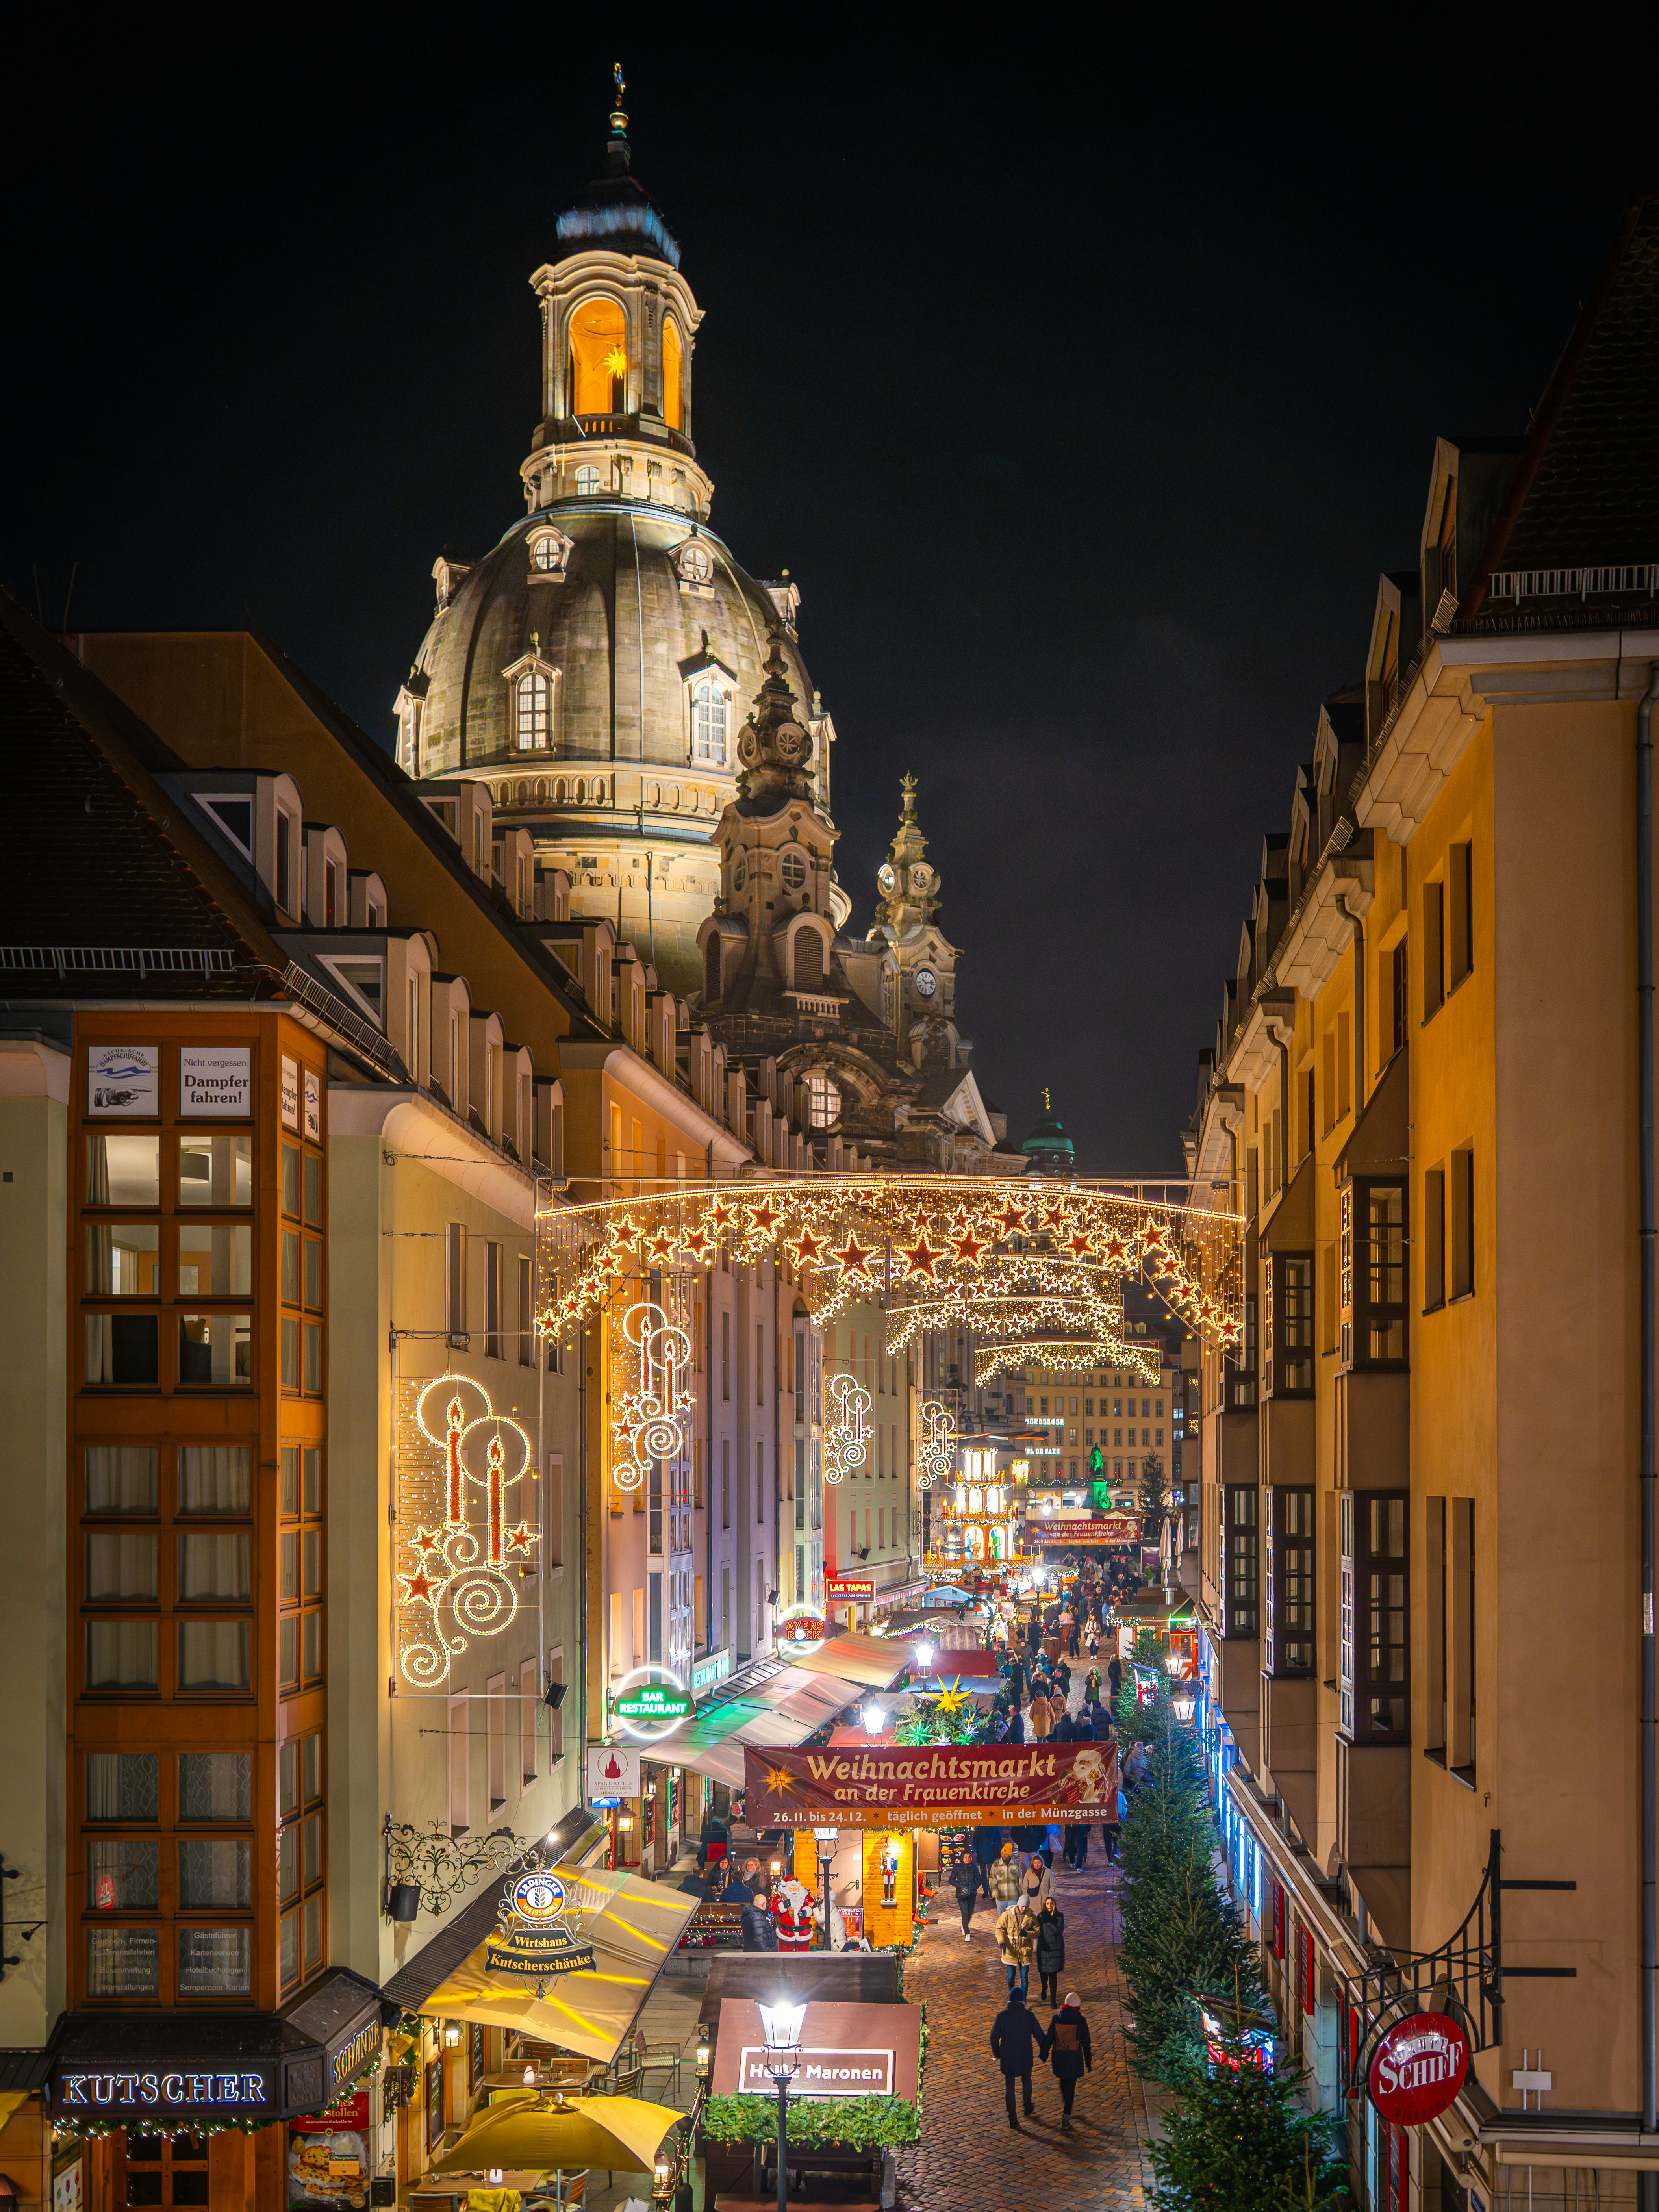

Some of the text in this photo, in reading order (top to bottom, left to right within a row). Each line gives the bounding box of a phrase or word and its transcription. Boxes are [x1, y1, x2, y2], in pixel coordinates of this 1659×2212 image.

[99, 1053, 148, 1068] DAMPFSCHIFFAHRT
[184, 1075, 249, 1090] Dampfer
[190, 1090, 242, 1103] fahren!
[282, 1097, 295, 1116] fahren!
[1044, 1521, 1121, 1530] Weihnachtsmarkt
[829, 1583, 872, 1592] LAS TAPAS
[786, 1621, 824, 1630] AYERS
[642, 1692, 664, 1702] BAR
[619, 1703, 687, 1713] RESTAURANT
[806, 1751, 1056, 1780] Weihnachtsmarkt
[834, 1781, 1030, 1801] an der Frauenkirche
[773, 1807, 1107, 1823] 26.11. bis 24.12. täglich geöffnet in der Münzgasse
[519, 1878, 560, 1895] ERDINGER
[515, 1936, 567, 1947] Wirtshaus
[489, 1953, 591, 1971] Kutscherschänke
[186, 1966, 244, 1975] Hotelbuchungen
[180, 1983, 250, 1992] Semperoper-Karten
[333, 2019, 379, 2085] SCHÄNKE
[806, 2064, 883, 2080] Maronen
[1379, 2041, 1463, 2094] SCHIFF
[61, 2073, 266, 2104] KUTSCHER
